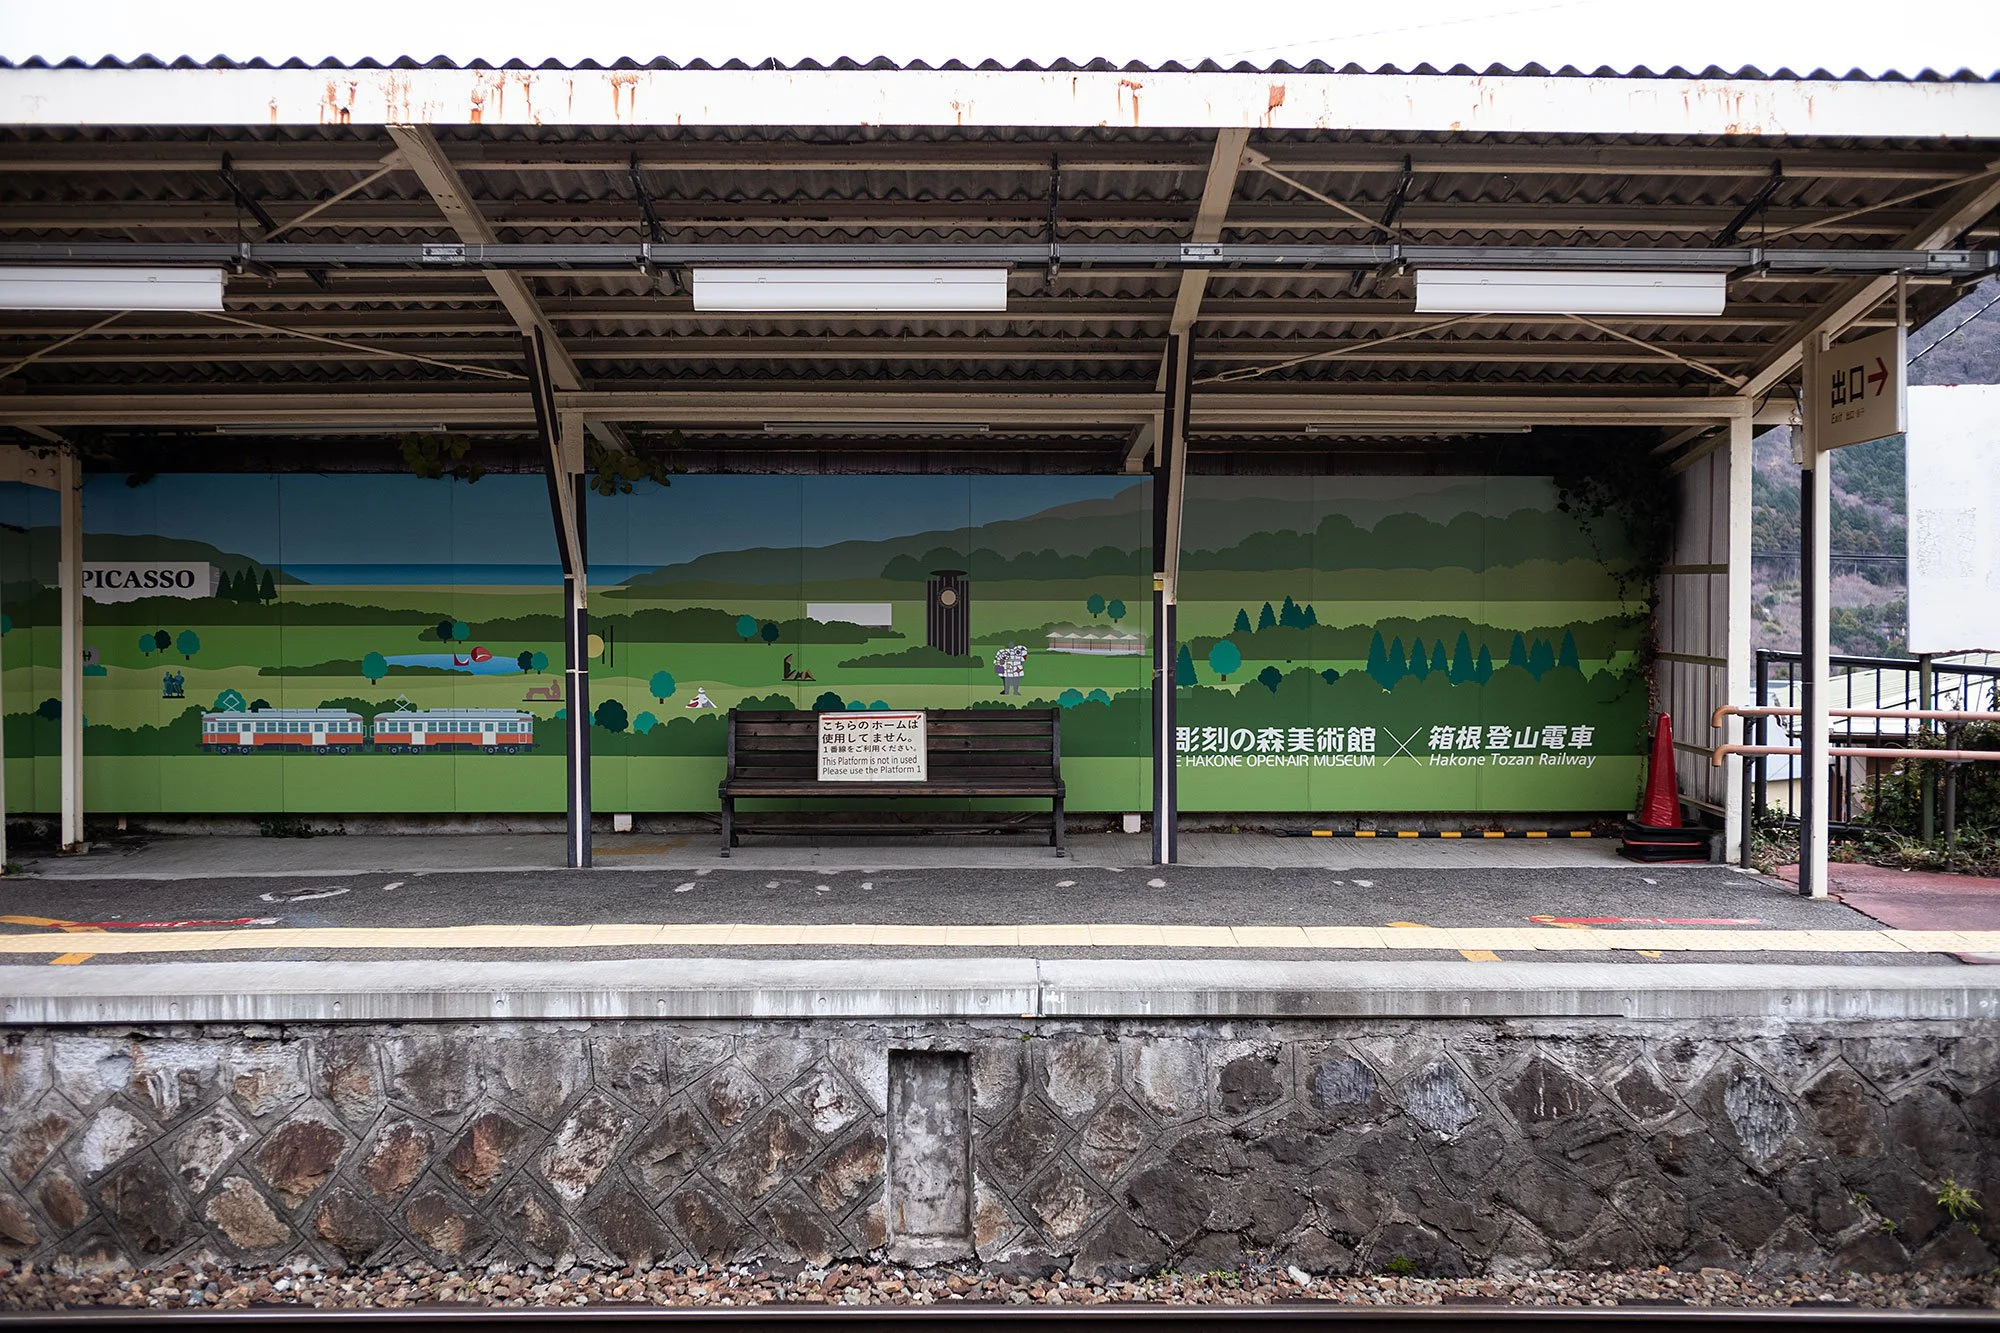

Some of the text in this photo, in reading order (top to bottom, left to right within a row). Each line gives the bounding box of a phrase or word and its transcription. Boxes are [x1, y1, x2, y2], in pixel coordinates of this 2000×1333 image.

[1831, 365, 1865, 408] 出口
[1831, 411, 1843, 424] Exit
[82, 570, 195, 589] PICASSO
[823, 720, 919, 731] こちらのホームは
[822, 733, 913, 744] 使用してません。
[1176, 726, 1376, 752] 彫刻の森美術館
[1427, 725, 1596, 750] 箱根登山電車
[823, 755, 918, 766] This Platform is not in used
[1185, 755, 1243, 767] HAKONE
[1246, 755, 1309, 767] OPEN-AIR
[1313, 755, 1376, 767] MUSEUM
[1429, 752, 1597, 768] Hakone Tozan Railway
[822, 767, 848, 775] Please
[917, 765, 922, 773] 1
